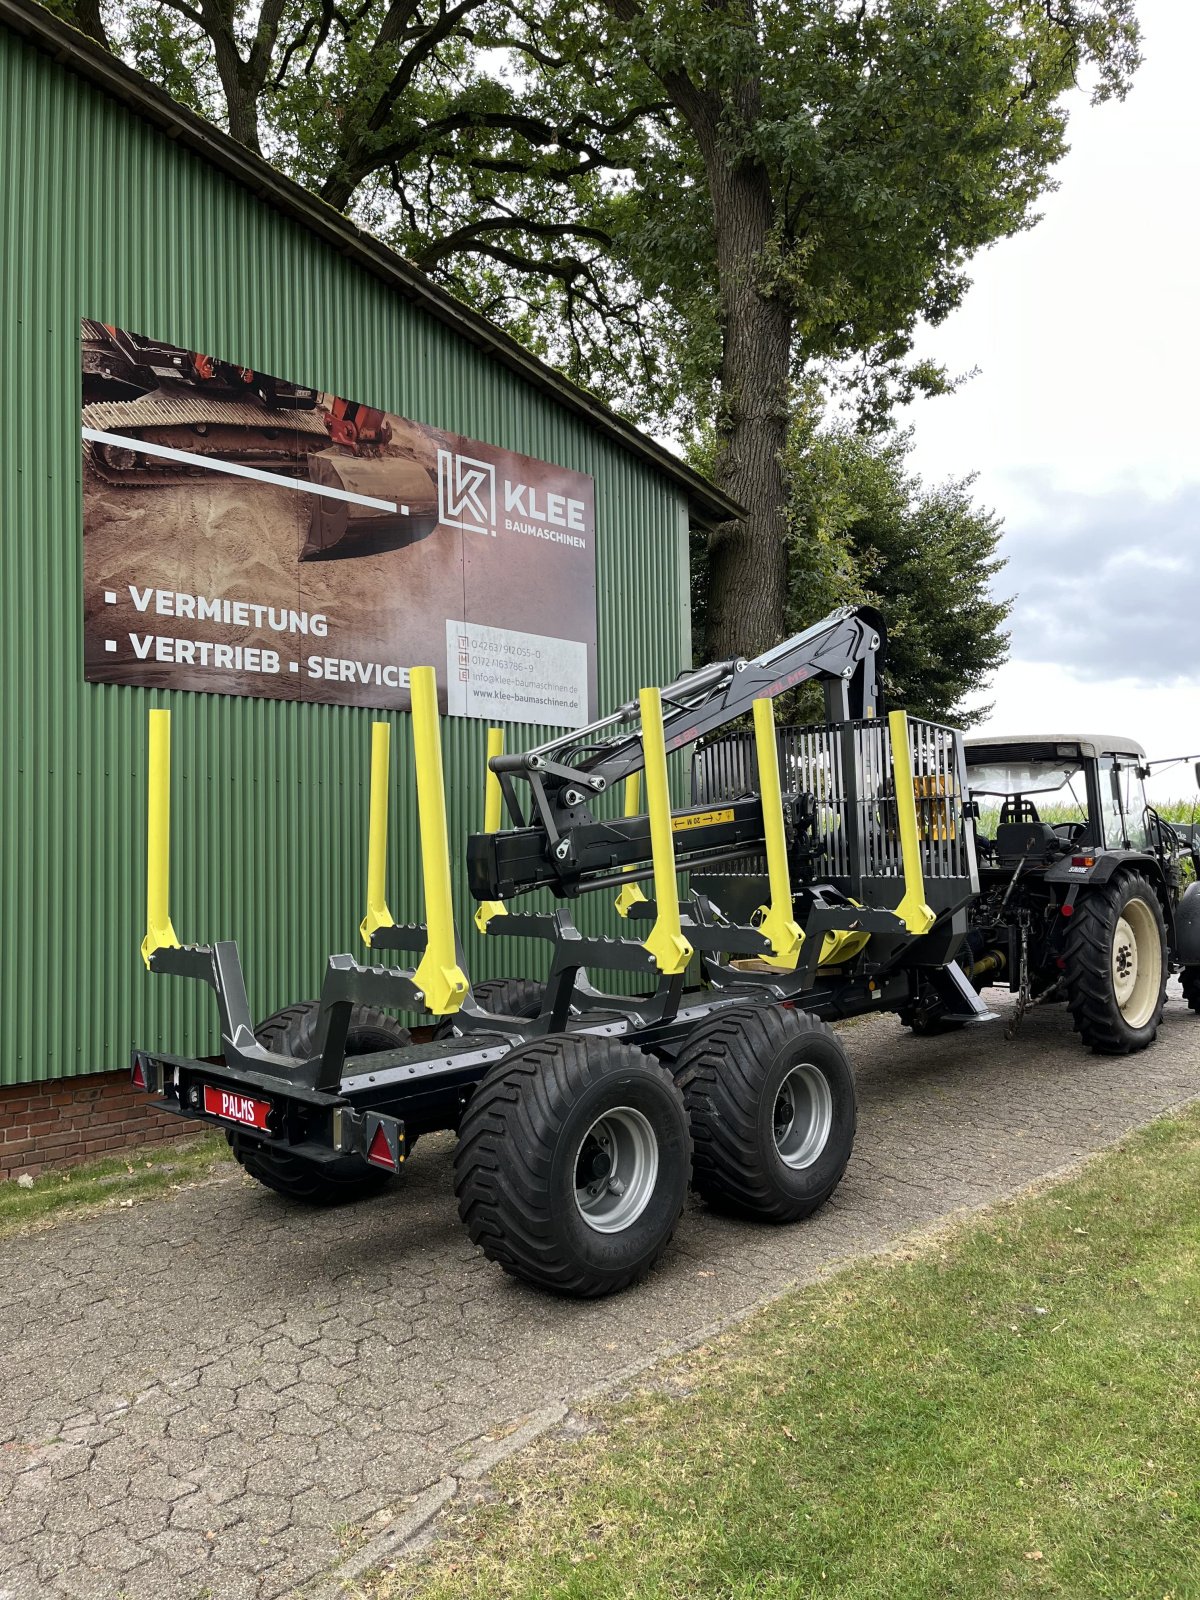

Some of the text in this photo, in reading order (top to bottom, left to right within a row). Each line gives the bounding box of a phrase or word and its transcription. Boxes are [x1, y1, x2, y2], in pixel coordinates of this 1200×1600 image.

[504, 479, 586, 532] KLEE
[505, 519, 586, 549] BAUMASCHINEN
[128, 585, 328, 637] VERMIETUNG
[128, 632, 411, 689] VERTRIEB SERVICE
[472, 671, 578, 695] info@klee-baumaschinen.de
[472, 688, 579, 709] www.klee-baumaschinen.de
[221, 1092, 255, 1122] PALMS
